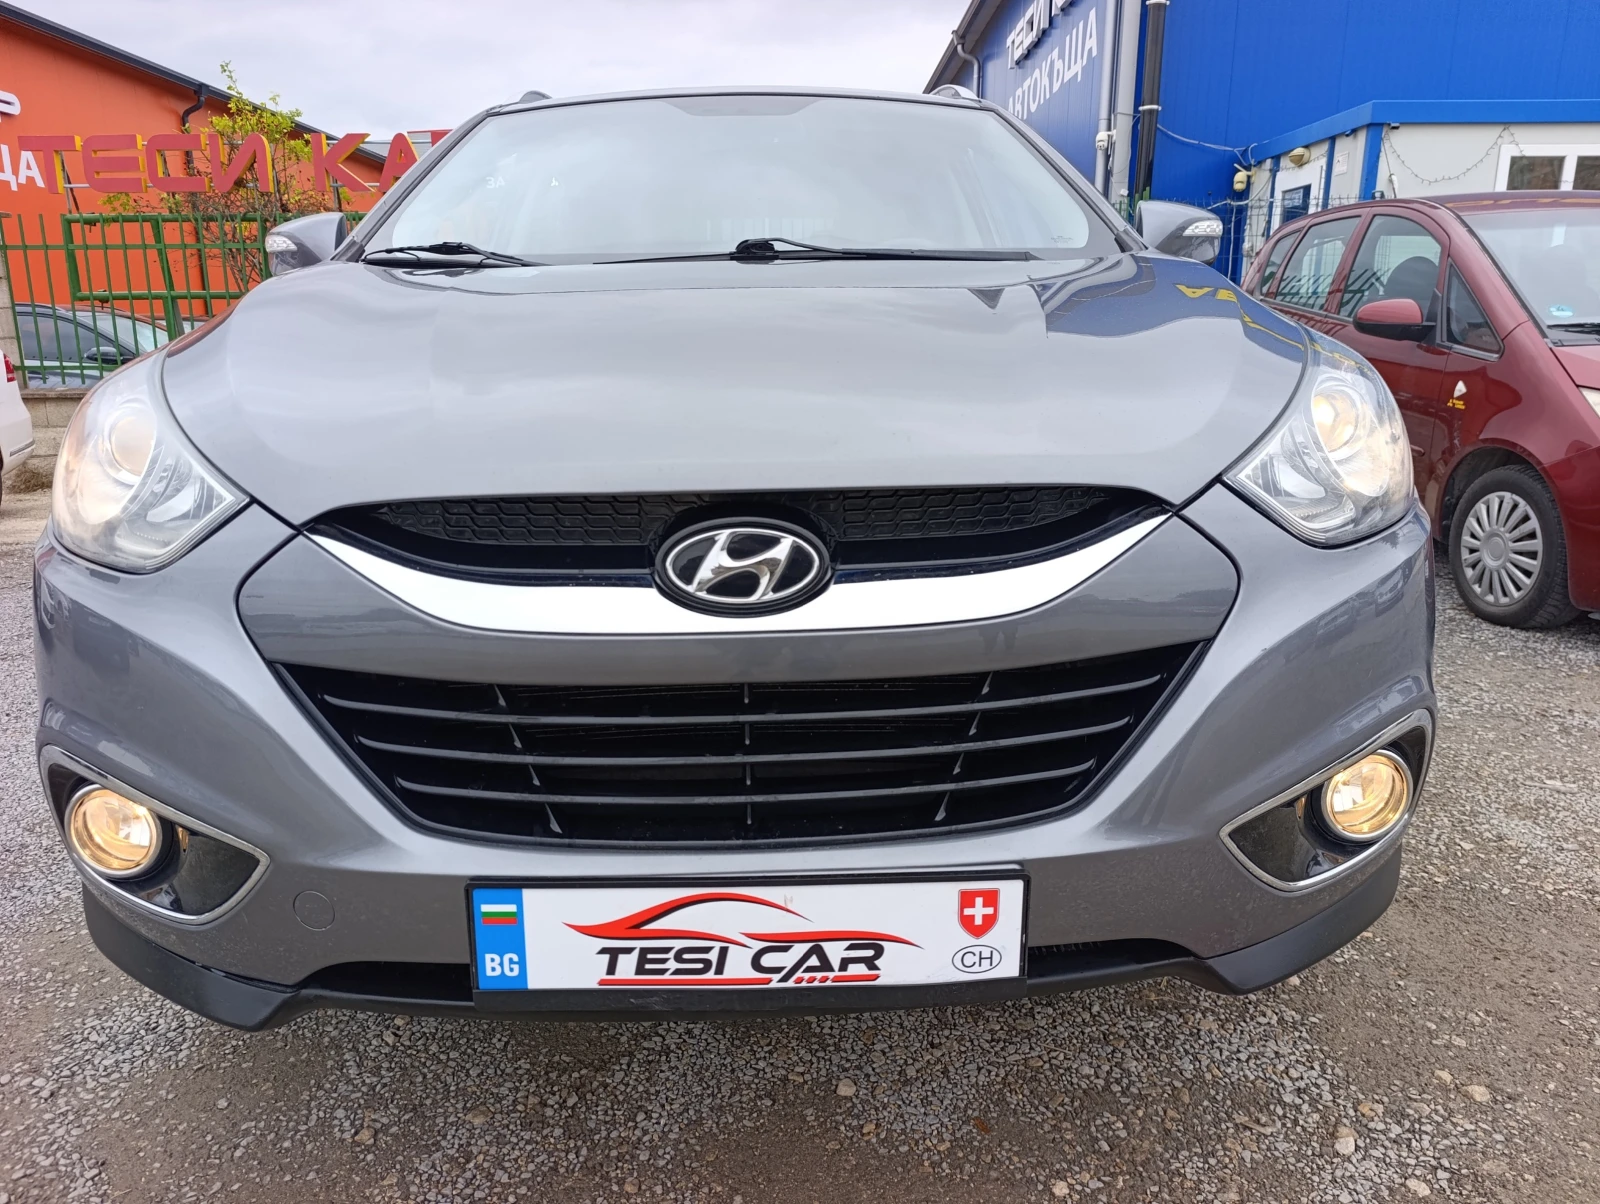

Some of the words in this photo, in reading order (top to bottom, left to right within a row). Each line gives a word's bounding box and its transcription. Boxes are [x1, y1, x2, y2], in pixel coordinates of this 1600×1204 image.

[1008, 7, 1097, 120] АВТОКЪЩА
[17, 133, 274, 194] ТЕСИ
[484, 953, 520, 977] BG
[595, 946, 729, 976] TESI
[750, 942, 885, 983] CAR
[960, 950, 993, 969] CH
